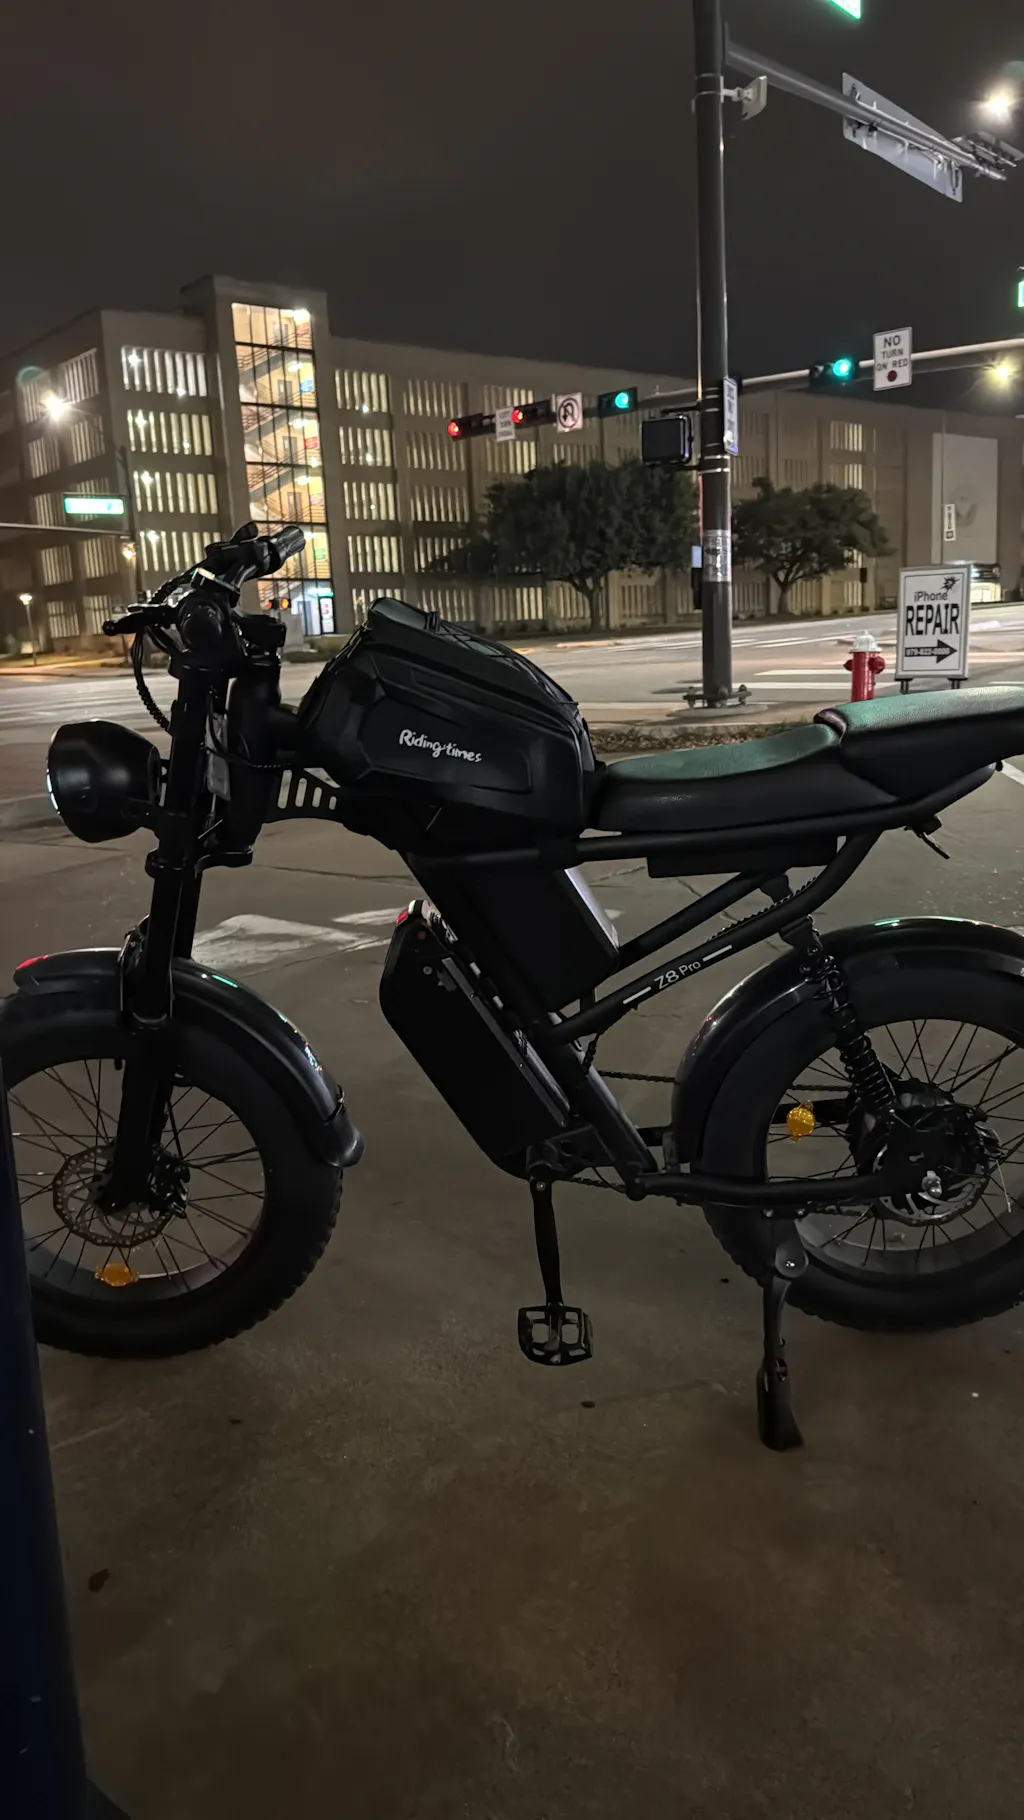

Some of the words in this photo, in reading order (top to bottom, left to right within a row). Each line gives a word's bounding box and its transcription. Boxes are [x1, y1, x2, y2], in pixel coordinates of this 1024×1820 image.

[883, 335, 901, 348] NO
[882, 349, 904, 358] TURN
[876, 363, 888, 371] ON
[892, 358, 908, 368] RED
[914, 591, 948, 602] iPhone
[905, 603, 960, 636] REPAIR
[653, 969, 680, 990] Z8
[678, 960, 701, 976] Pro
